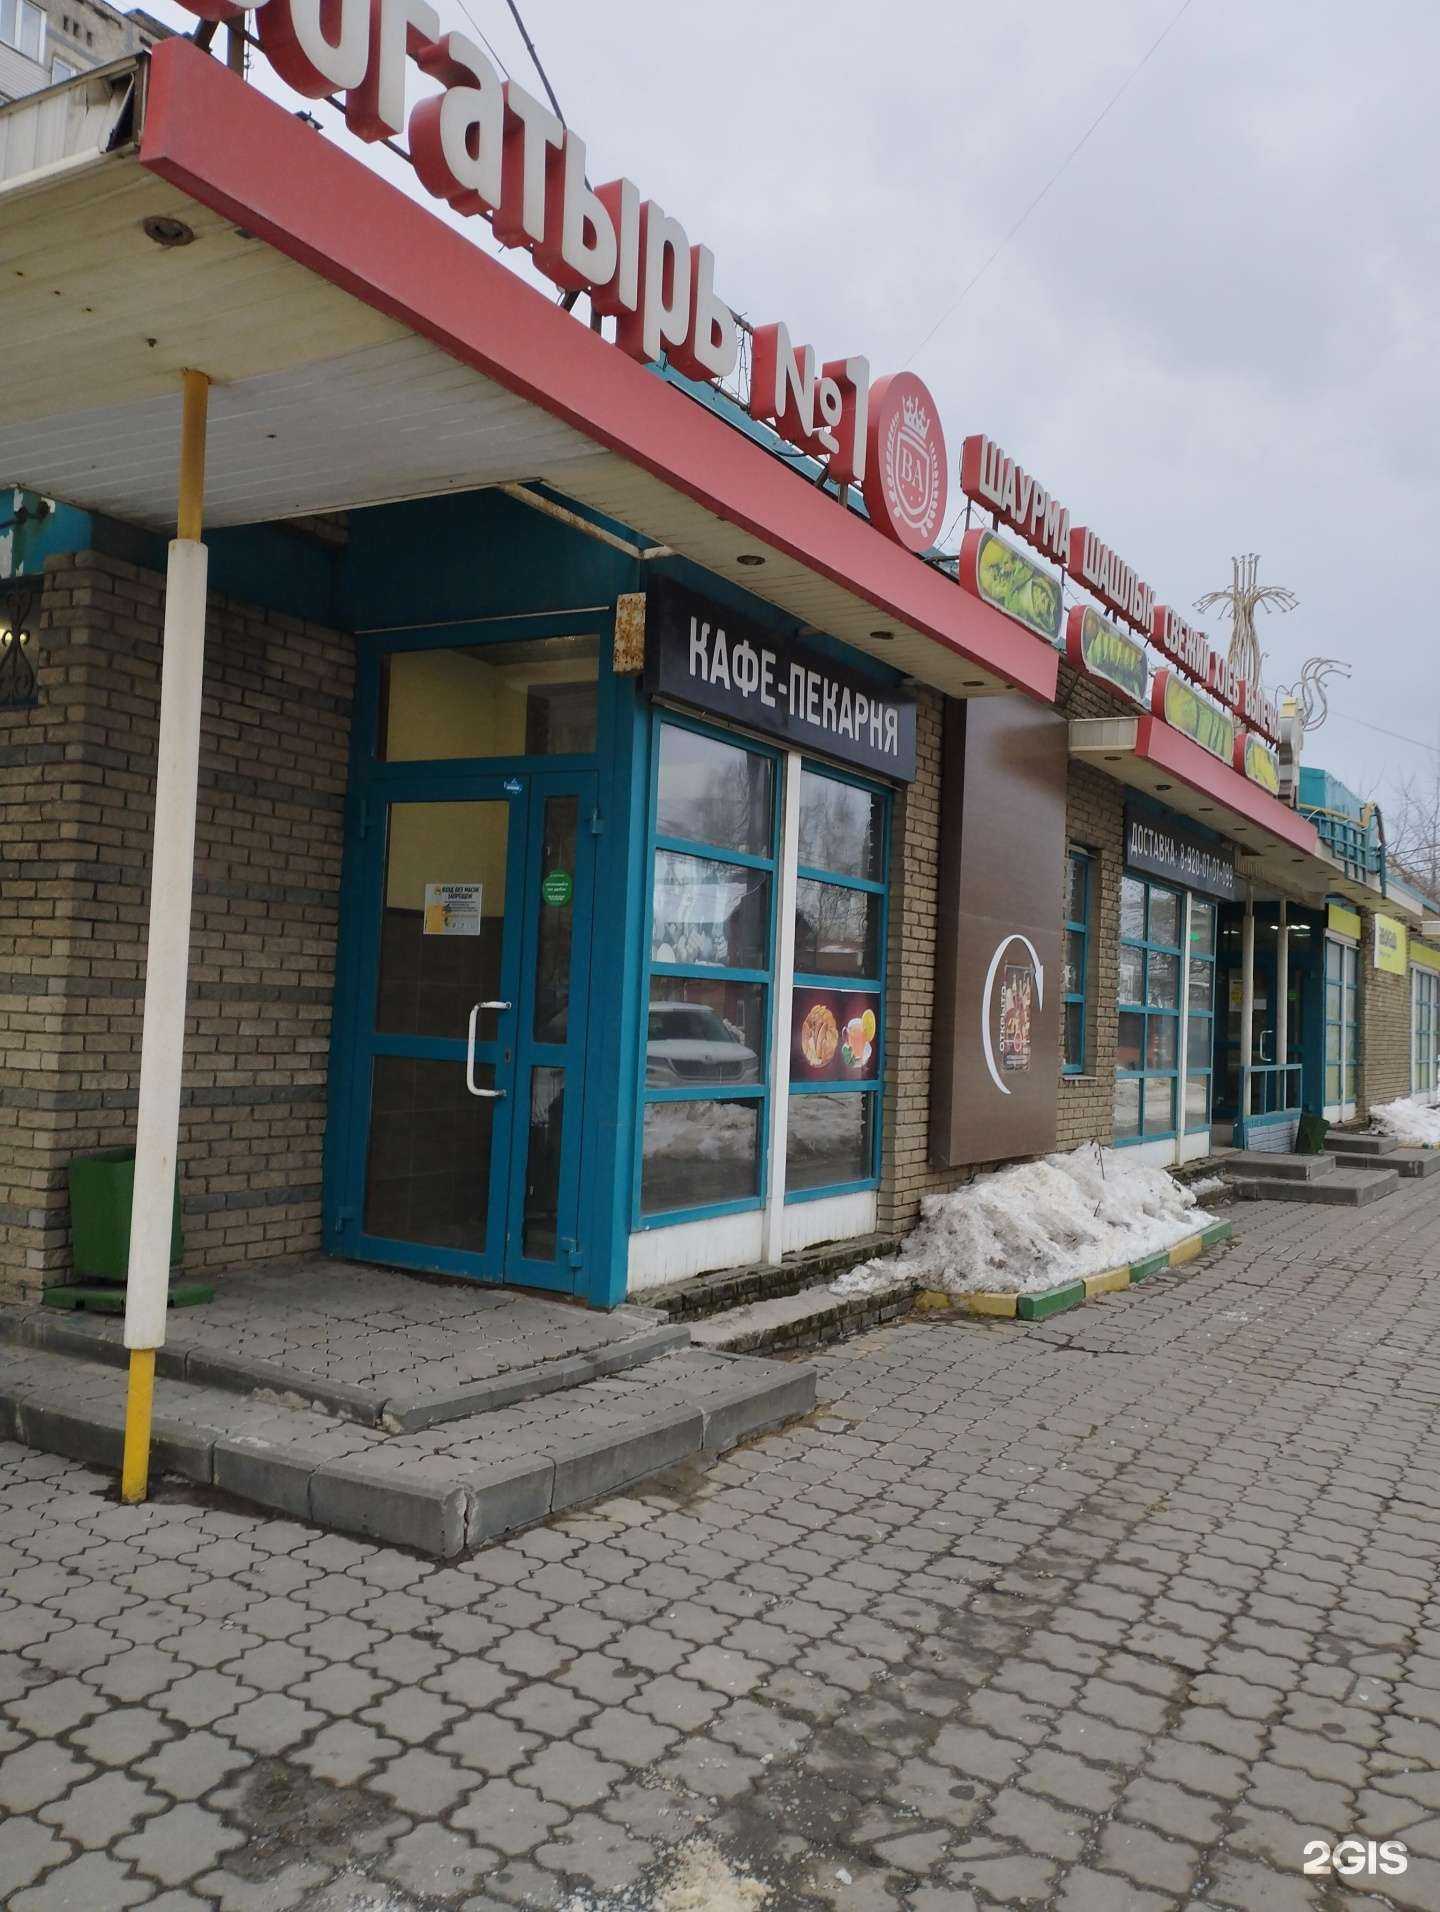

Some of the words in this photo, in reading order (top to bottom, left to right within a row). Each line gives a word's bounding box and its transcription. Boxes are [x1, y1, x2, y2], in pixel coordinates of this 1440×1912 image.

[236, 0, 738, 377] гатырь
[978, 434, 1071, 563] ШАУРМА
[1083, 527, 1154, 634] ШАШЛЫК
[688, 615, 898, 756] КАФЕ-ПЕКАРНЯ
[1130, 822, 1178, 867] ДОСТАВКА:
